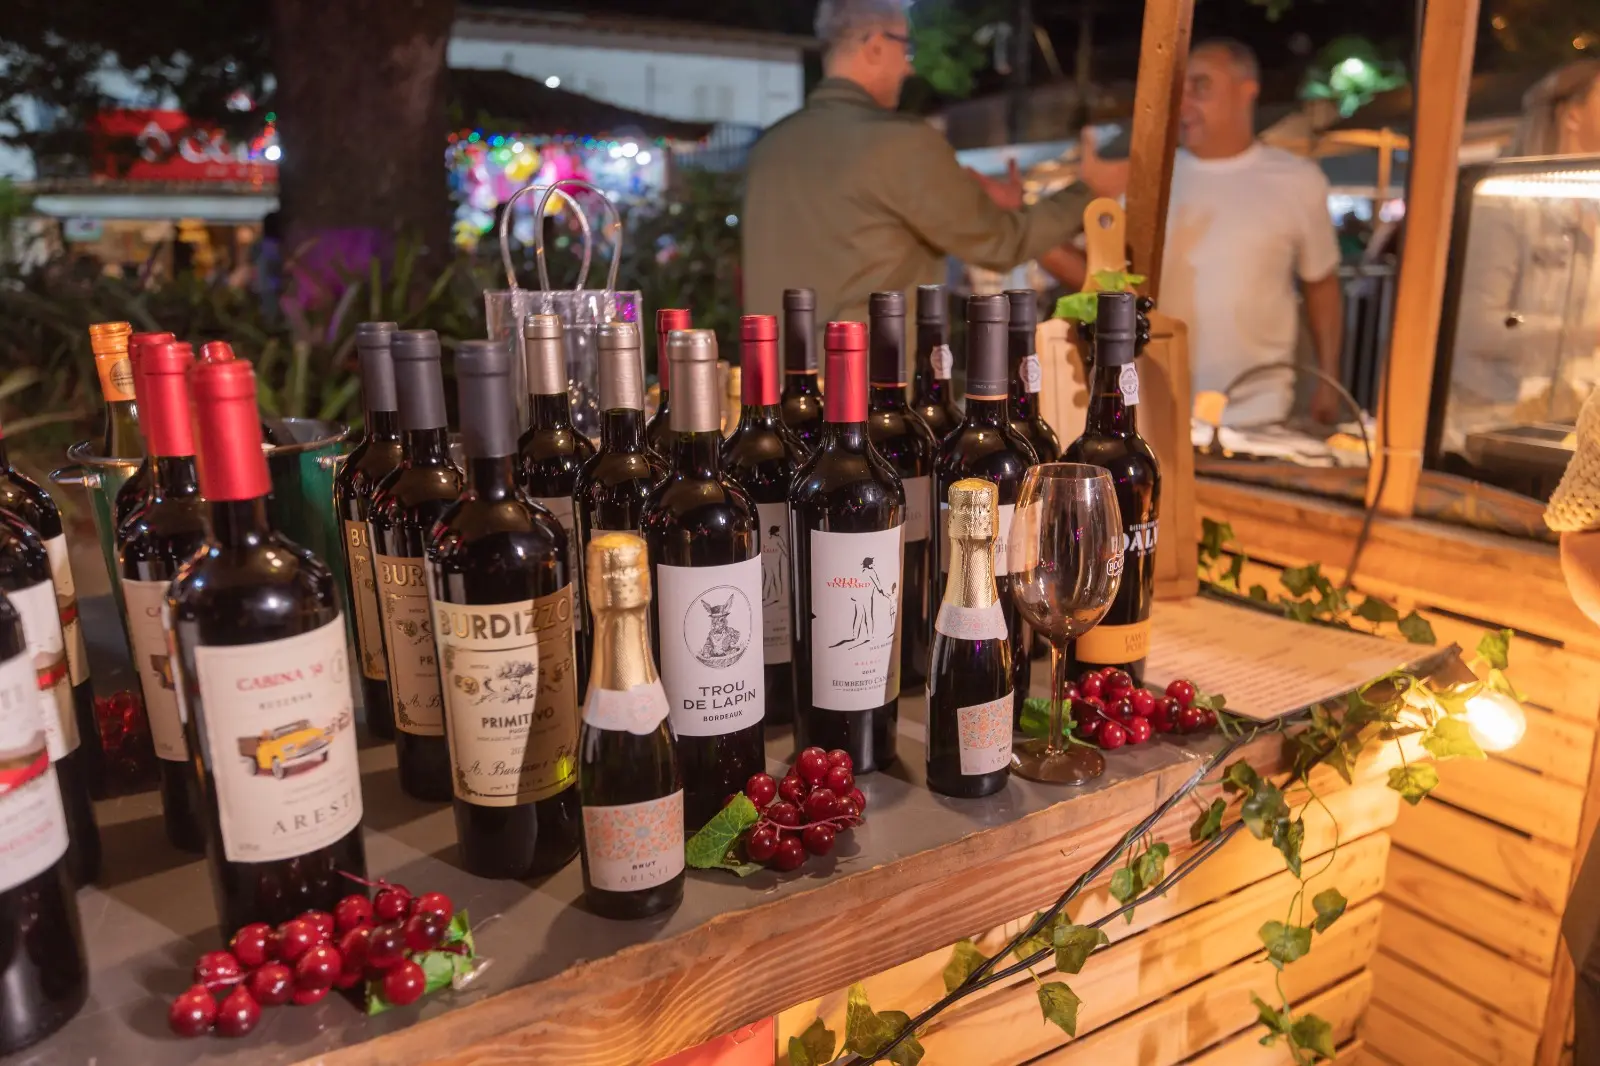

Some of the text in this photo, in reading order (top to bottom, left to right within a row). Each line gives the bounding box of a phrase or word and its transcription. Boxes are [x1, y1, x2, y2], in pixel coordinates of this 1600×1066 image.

[438, 597, 571, 640] BURDIZZO
[683, 688, 756, 710] DE LAPIN
[698, 680, 745, 697] TROU
[481, 706, 555, 729] PRIMITIVO
[703, 709, 743, 722] BORDEAUX
